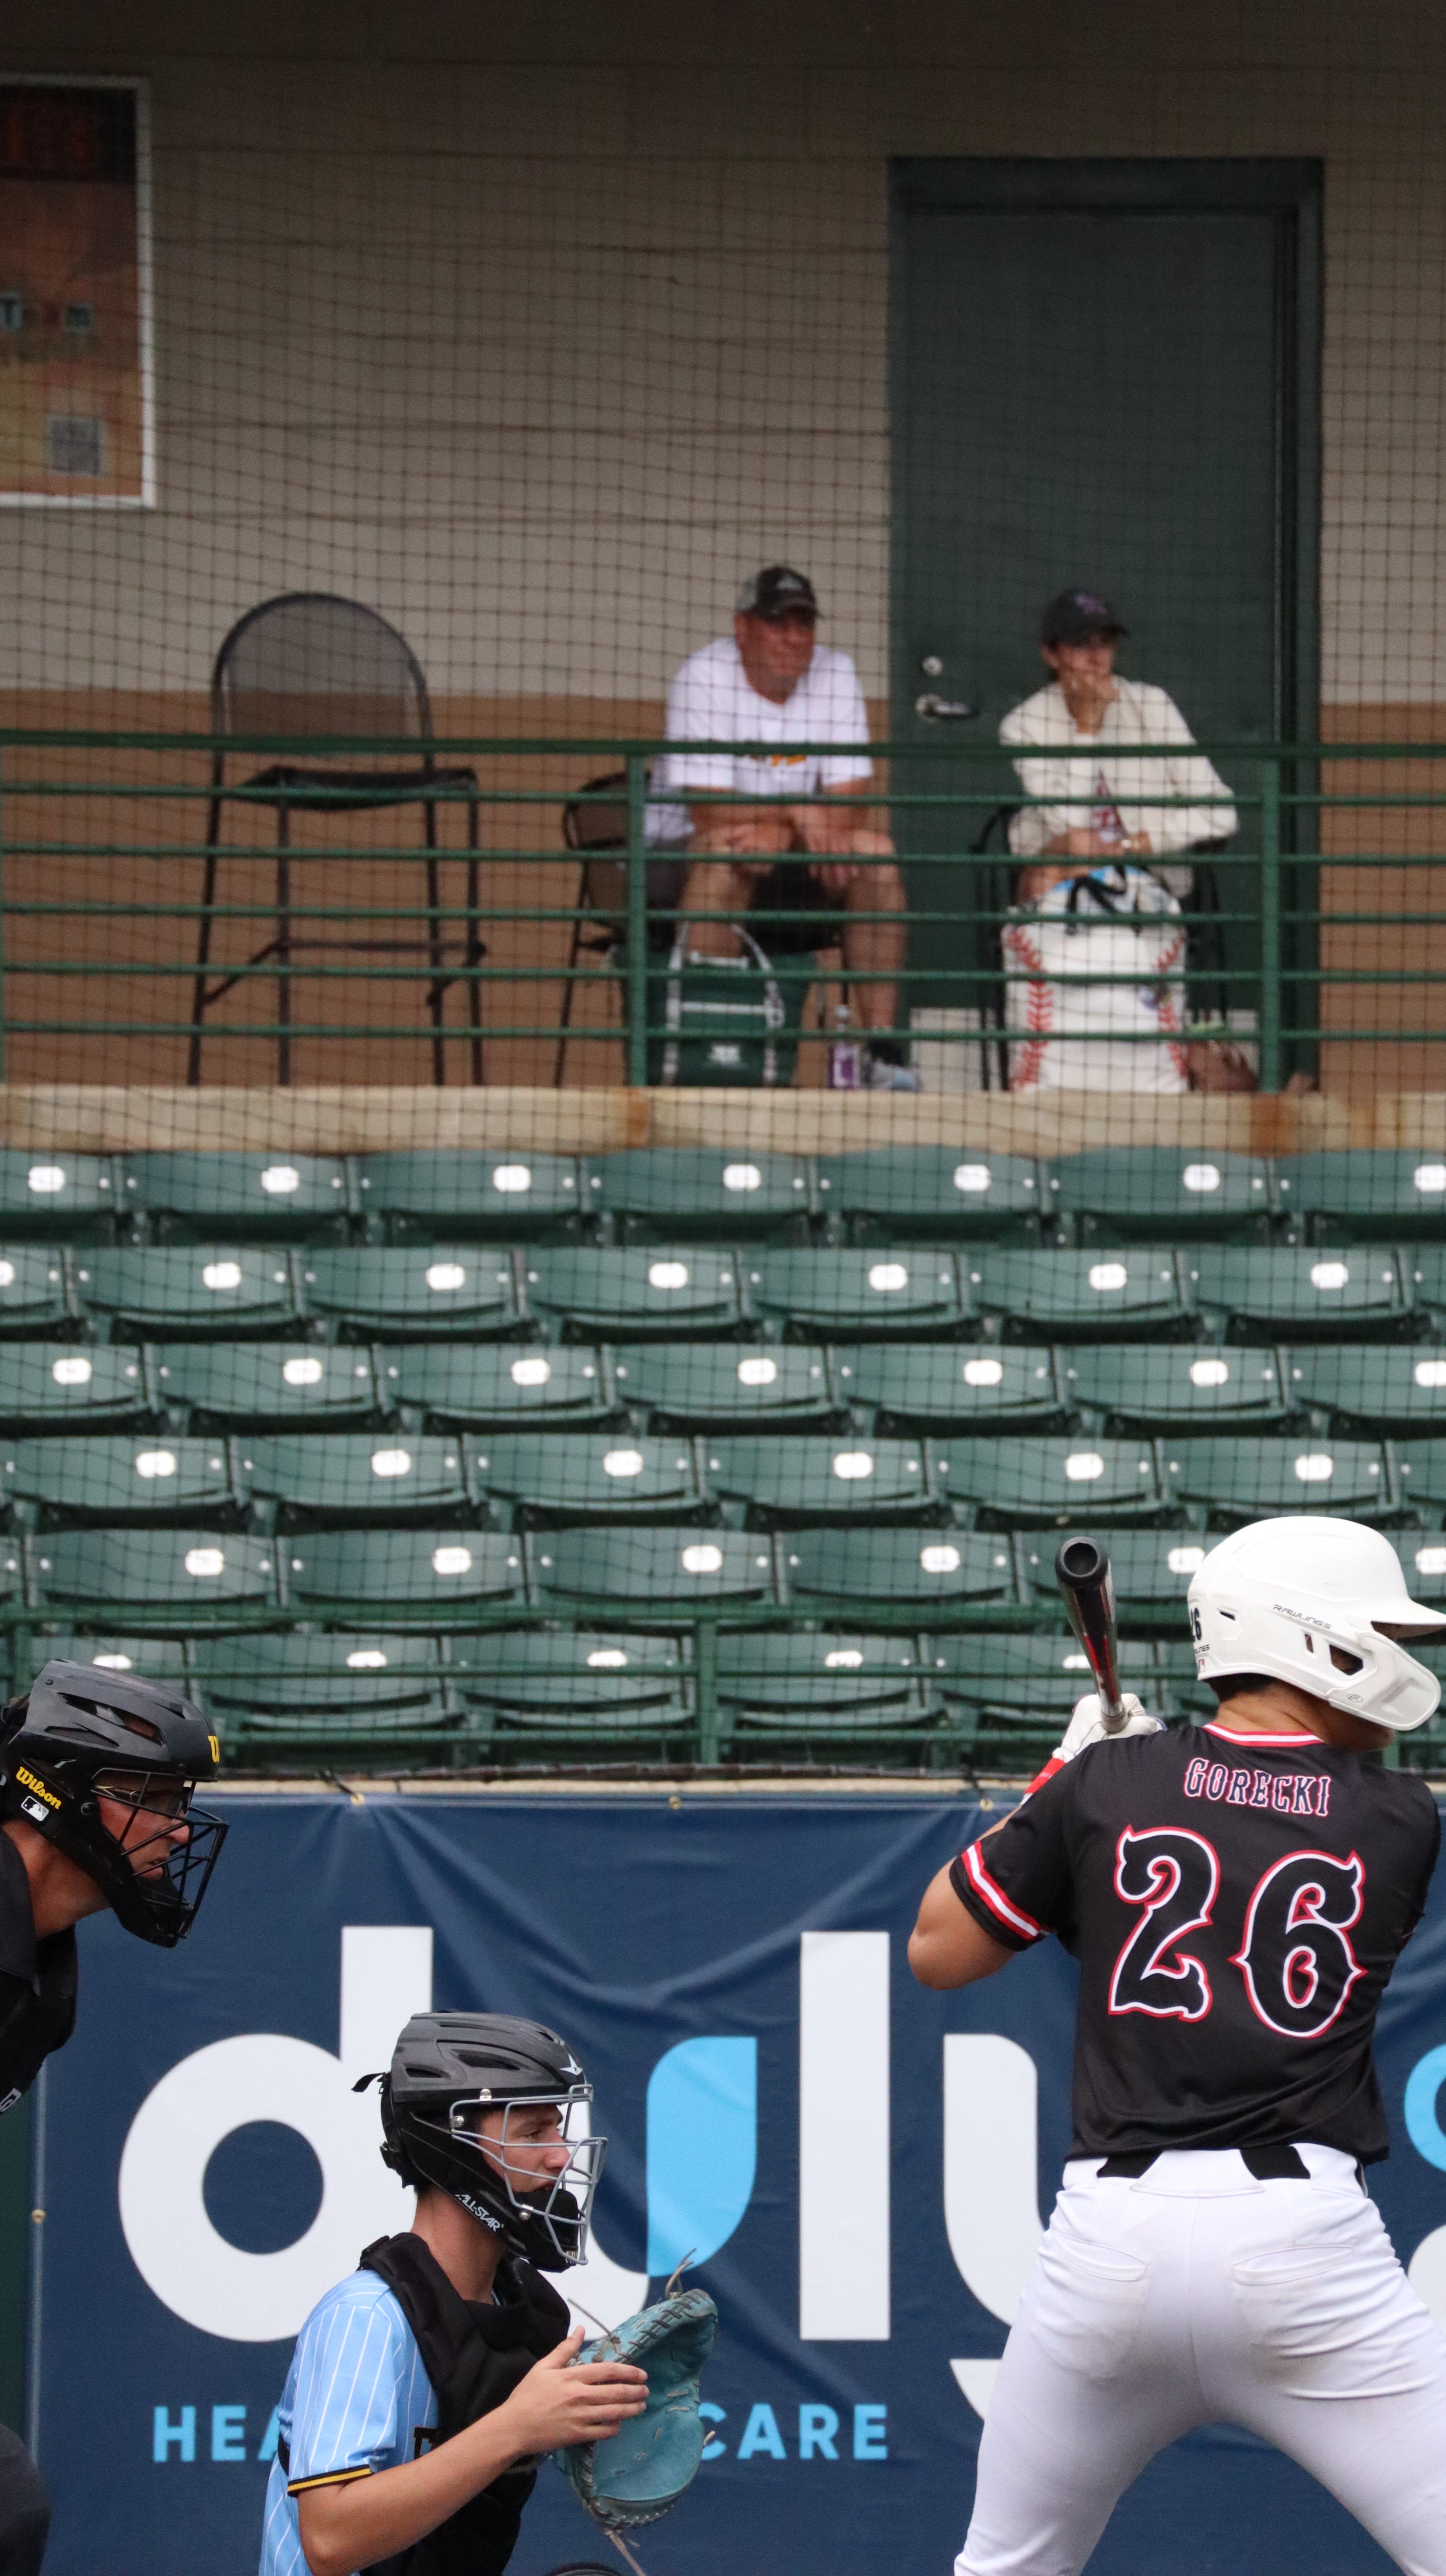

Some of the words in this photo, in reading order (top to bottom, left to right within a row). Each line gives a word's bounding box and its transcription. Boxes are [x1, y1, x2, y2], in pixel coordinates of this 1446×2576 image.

[1272, 1604, 1332, 1630] RAWLINGS
[15, 1766, 62, 1810] Wilson
[1184, 1757, 1332, 1817] GORECKI
[1108, 1824, 1369, 2038] 26
[698, 2402, 888, 2461] CARE
